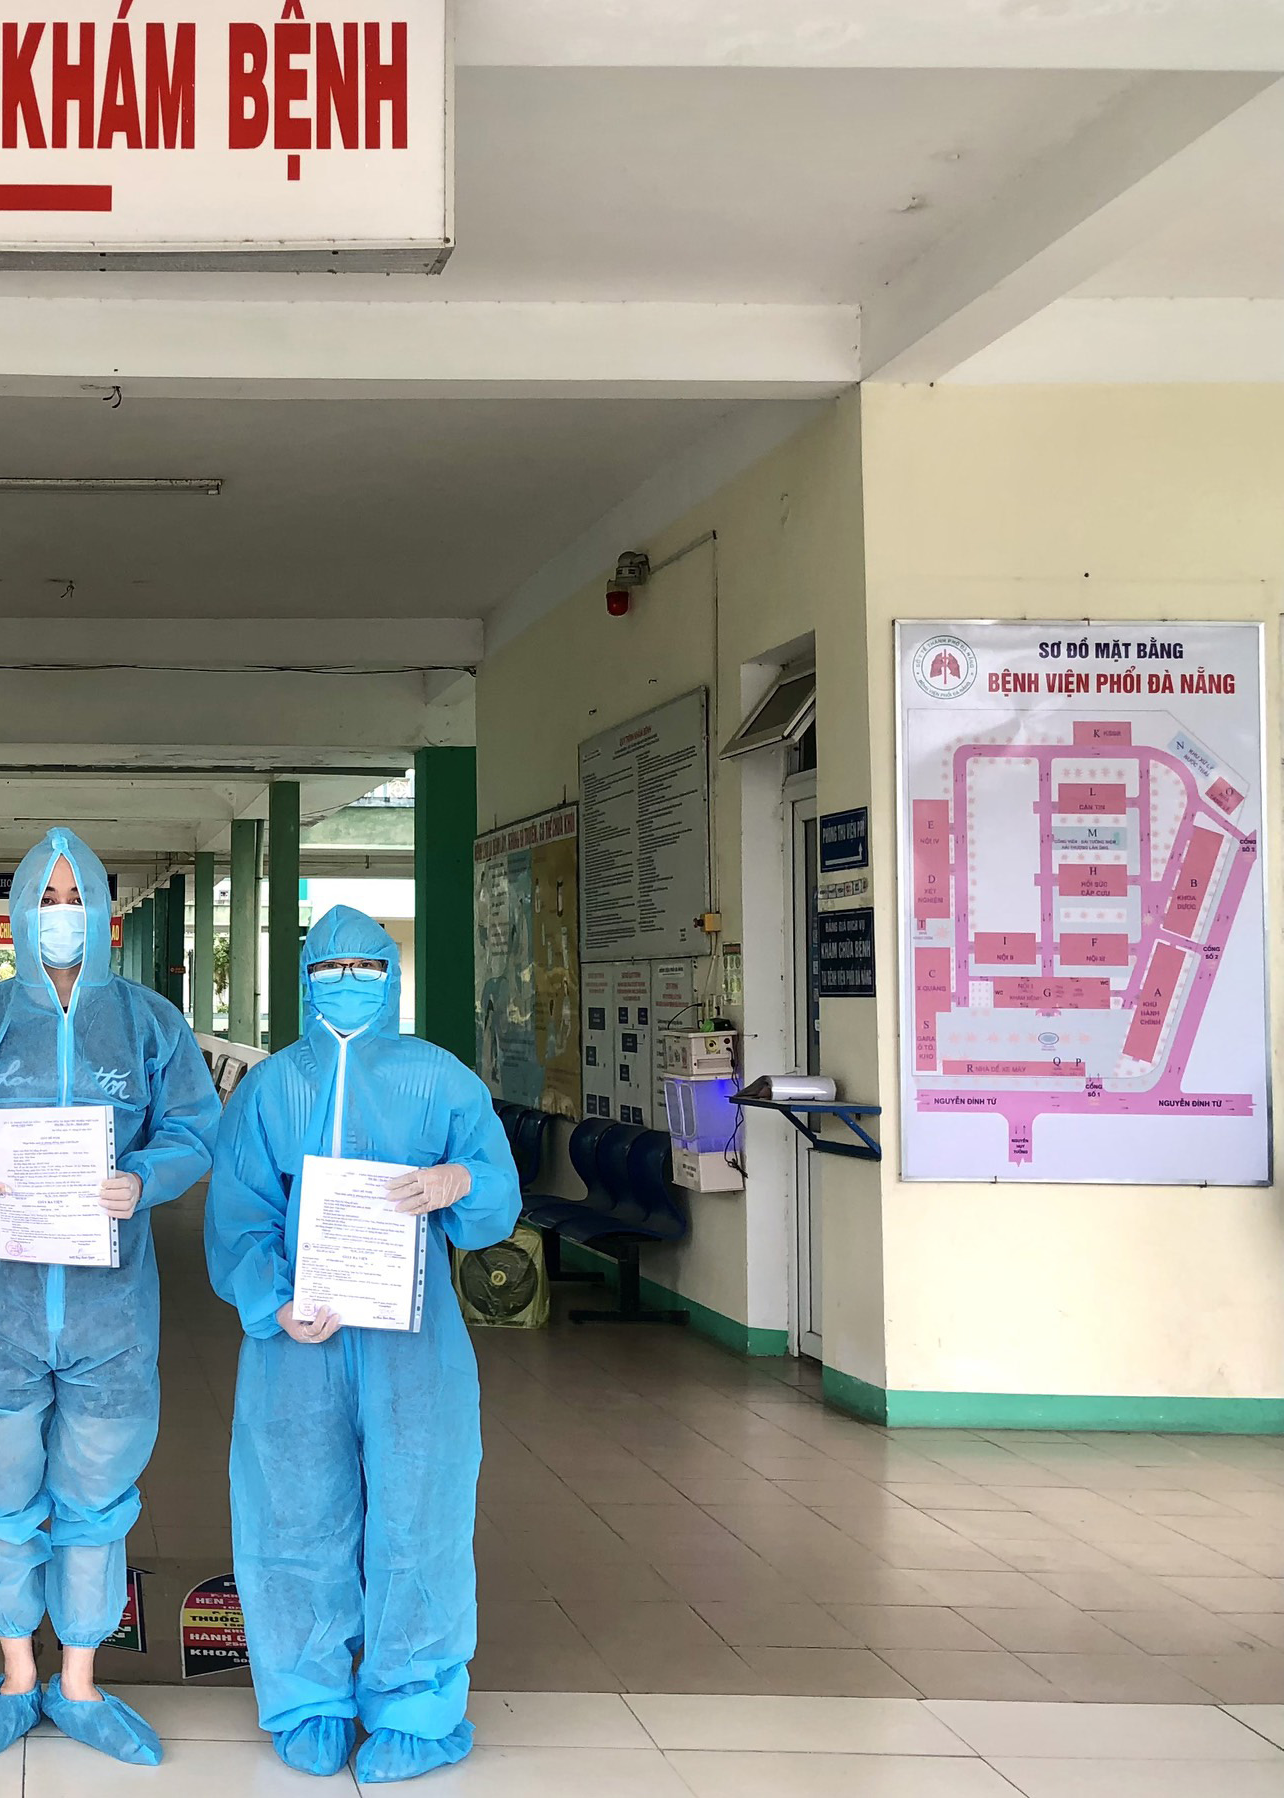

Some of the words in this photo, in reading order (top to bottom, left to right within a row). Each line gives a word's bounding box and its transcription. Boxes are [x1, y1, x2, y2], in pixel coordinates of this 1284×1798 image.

[2, 0, 195, 148] KHÁM
[228, 0, 408, 180] BỆNH
[1038, 641, 1061, 658] SƠ
[1066, 637, 1089, 658] ĐỔ
[1095, 640, 1131, 662] MẶT
[1137, 637, 1183, 659] BẰNG
[988, 668, 1039, 697] BỆNH
[1045, 669, 1089, 697] VIỆN
[1096, 665, 1141, 694] PHỔI
[1148, 670, 1174, 694] ĐÀ
[1180, 666, 1235, 694] NẴNG
[1094, 729, 1100, 738] K
[1090, 787, 1096, 796] L
[928, 820, 934, 829] E
[1088, 829, 1097, 837] M
[1089, 866, 1097, 875] H
[928, 875, 936, 884] D
[1190, 879, 1197, 888] B
[919, 920, 925, 928] T
[1092, 938, 1098, 947] F
[929, 970, 936, 978] C
[1043, 988, 1051, 997] G
[1154, 988, 1162, 997] A
[923, 1020, 929, 1029] S
[1053, 1056, 1061, 1066] Q
[1076, 1058, 1081, 1067] P
[966, 1064, 973, 1072] R
[934, 1096, 965, 1104] NGUYỄN
[967, 1096, 985, 1104] ĐÌNH
[987, 1097, 997, 1105] TỨ
[1158, 1098, 1190, 1107] NGUYỄN
[1192, 1098, 1210, 1107] ĐÌNH
[1212, 1099, 1222, 1107] TỨ
[190, 1633, 232, 1641] HÀNH
[190, 1649, 239, 1657] KHOA
